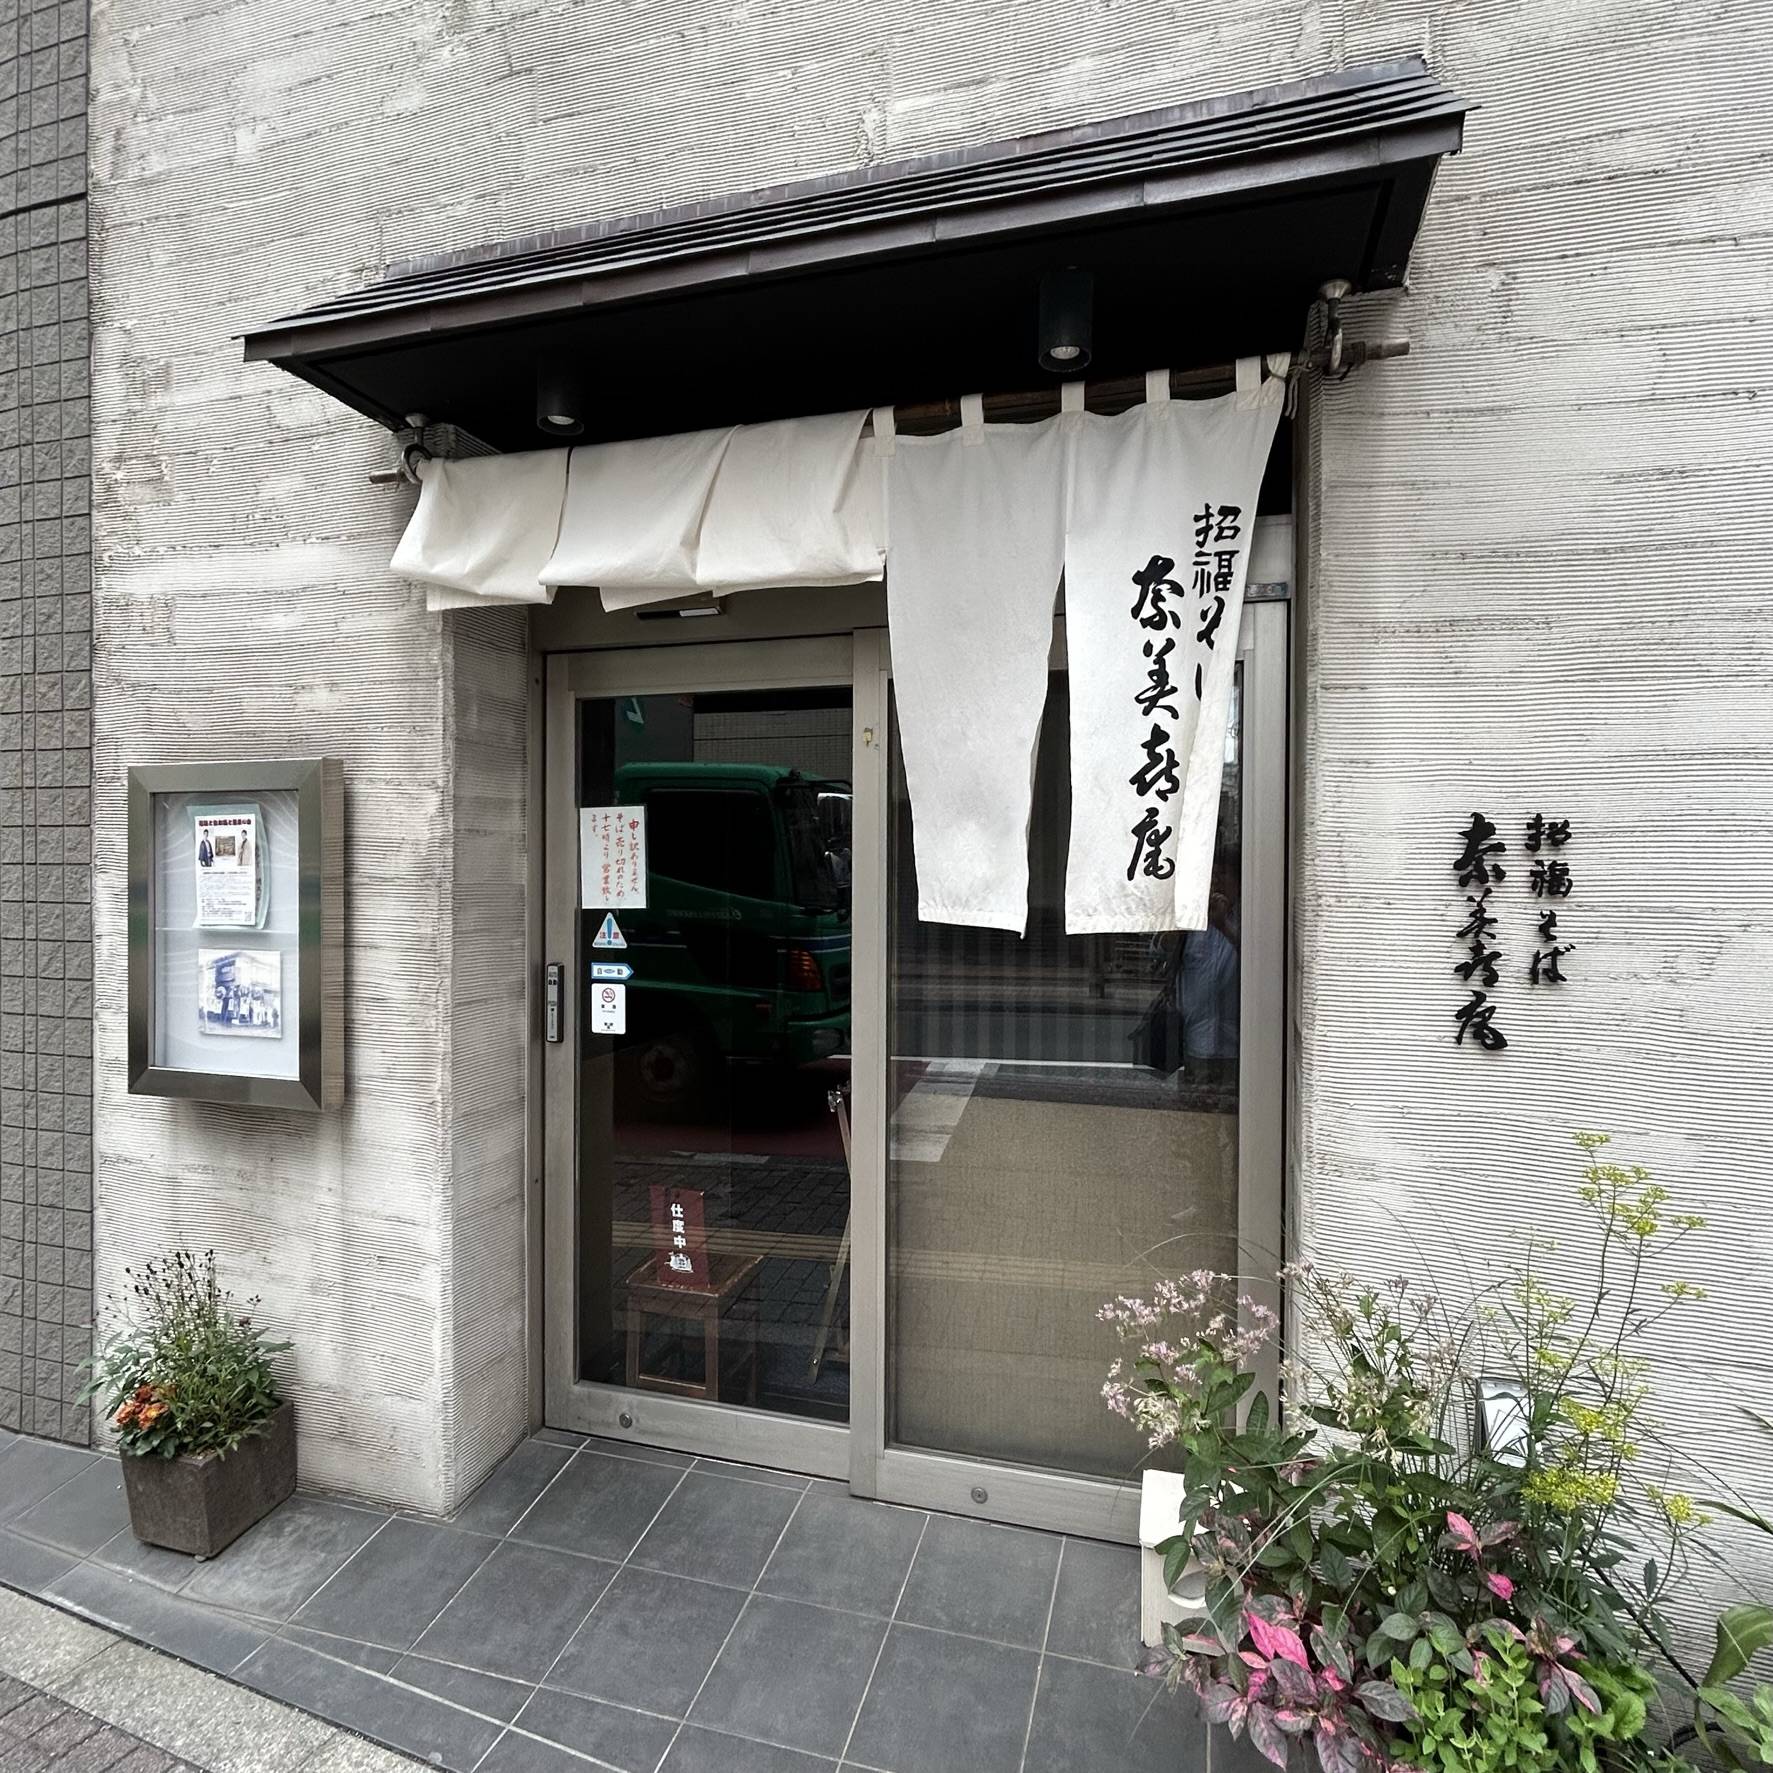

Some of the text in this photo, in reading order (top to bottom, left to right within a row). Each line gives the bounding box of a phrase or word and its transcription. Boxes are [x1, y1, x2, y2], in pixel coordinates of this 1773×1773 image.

[1191, 502, 1242, 702] 招福そ
[1523, 812, 1577, 986] 招福そば
[669, 1202, 688, 1250] 仕度中
